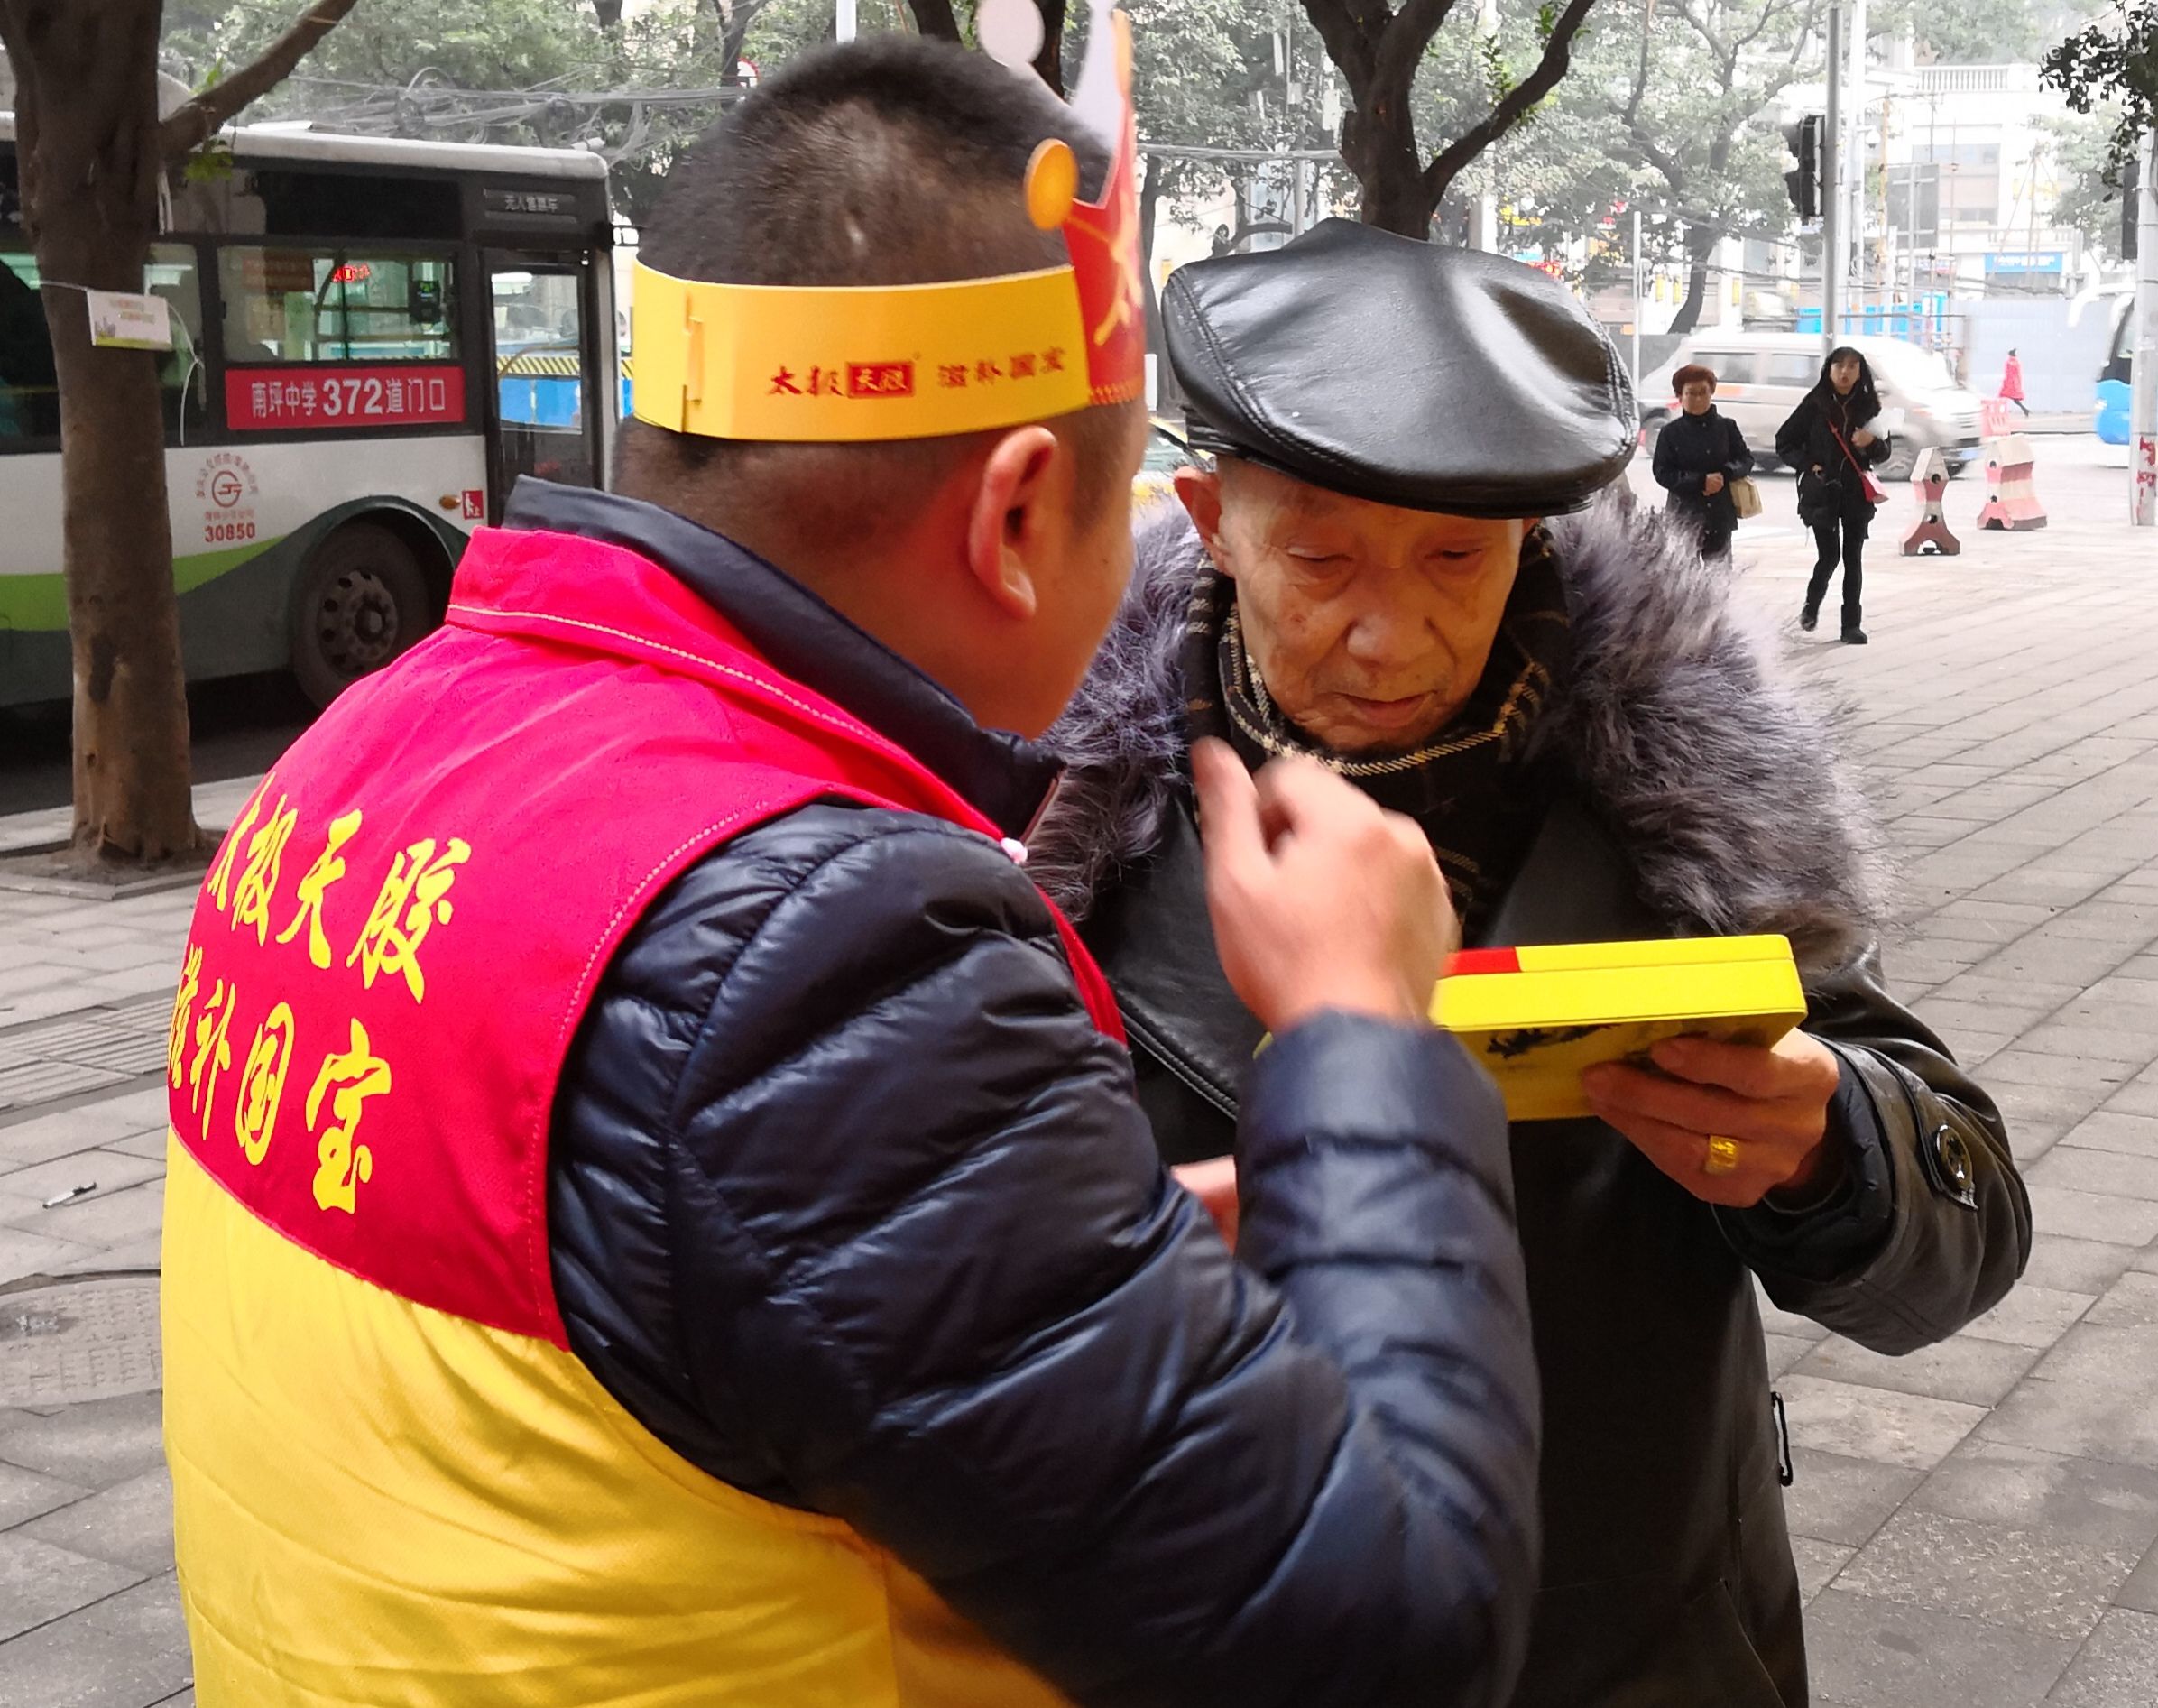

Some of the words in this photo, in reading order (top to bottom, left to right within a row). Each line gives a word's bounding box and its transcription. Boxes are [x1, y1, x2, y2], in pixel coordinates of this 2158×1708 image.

[251, 380, 317, 419] 南坪中学
[322, 377, 383, 416] 372
[384, 377, 446, 414] 道门口
[204, 522, 256, 543] 30850
